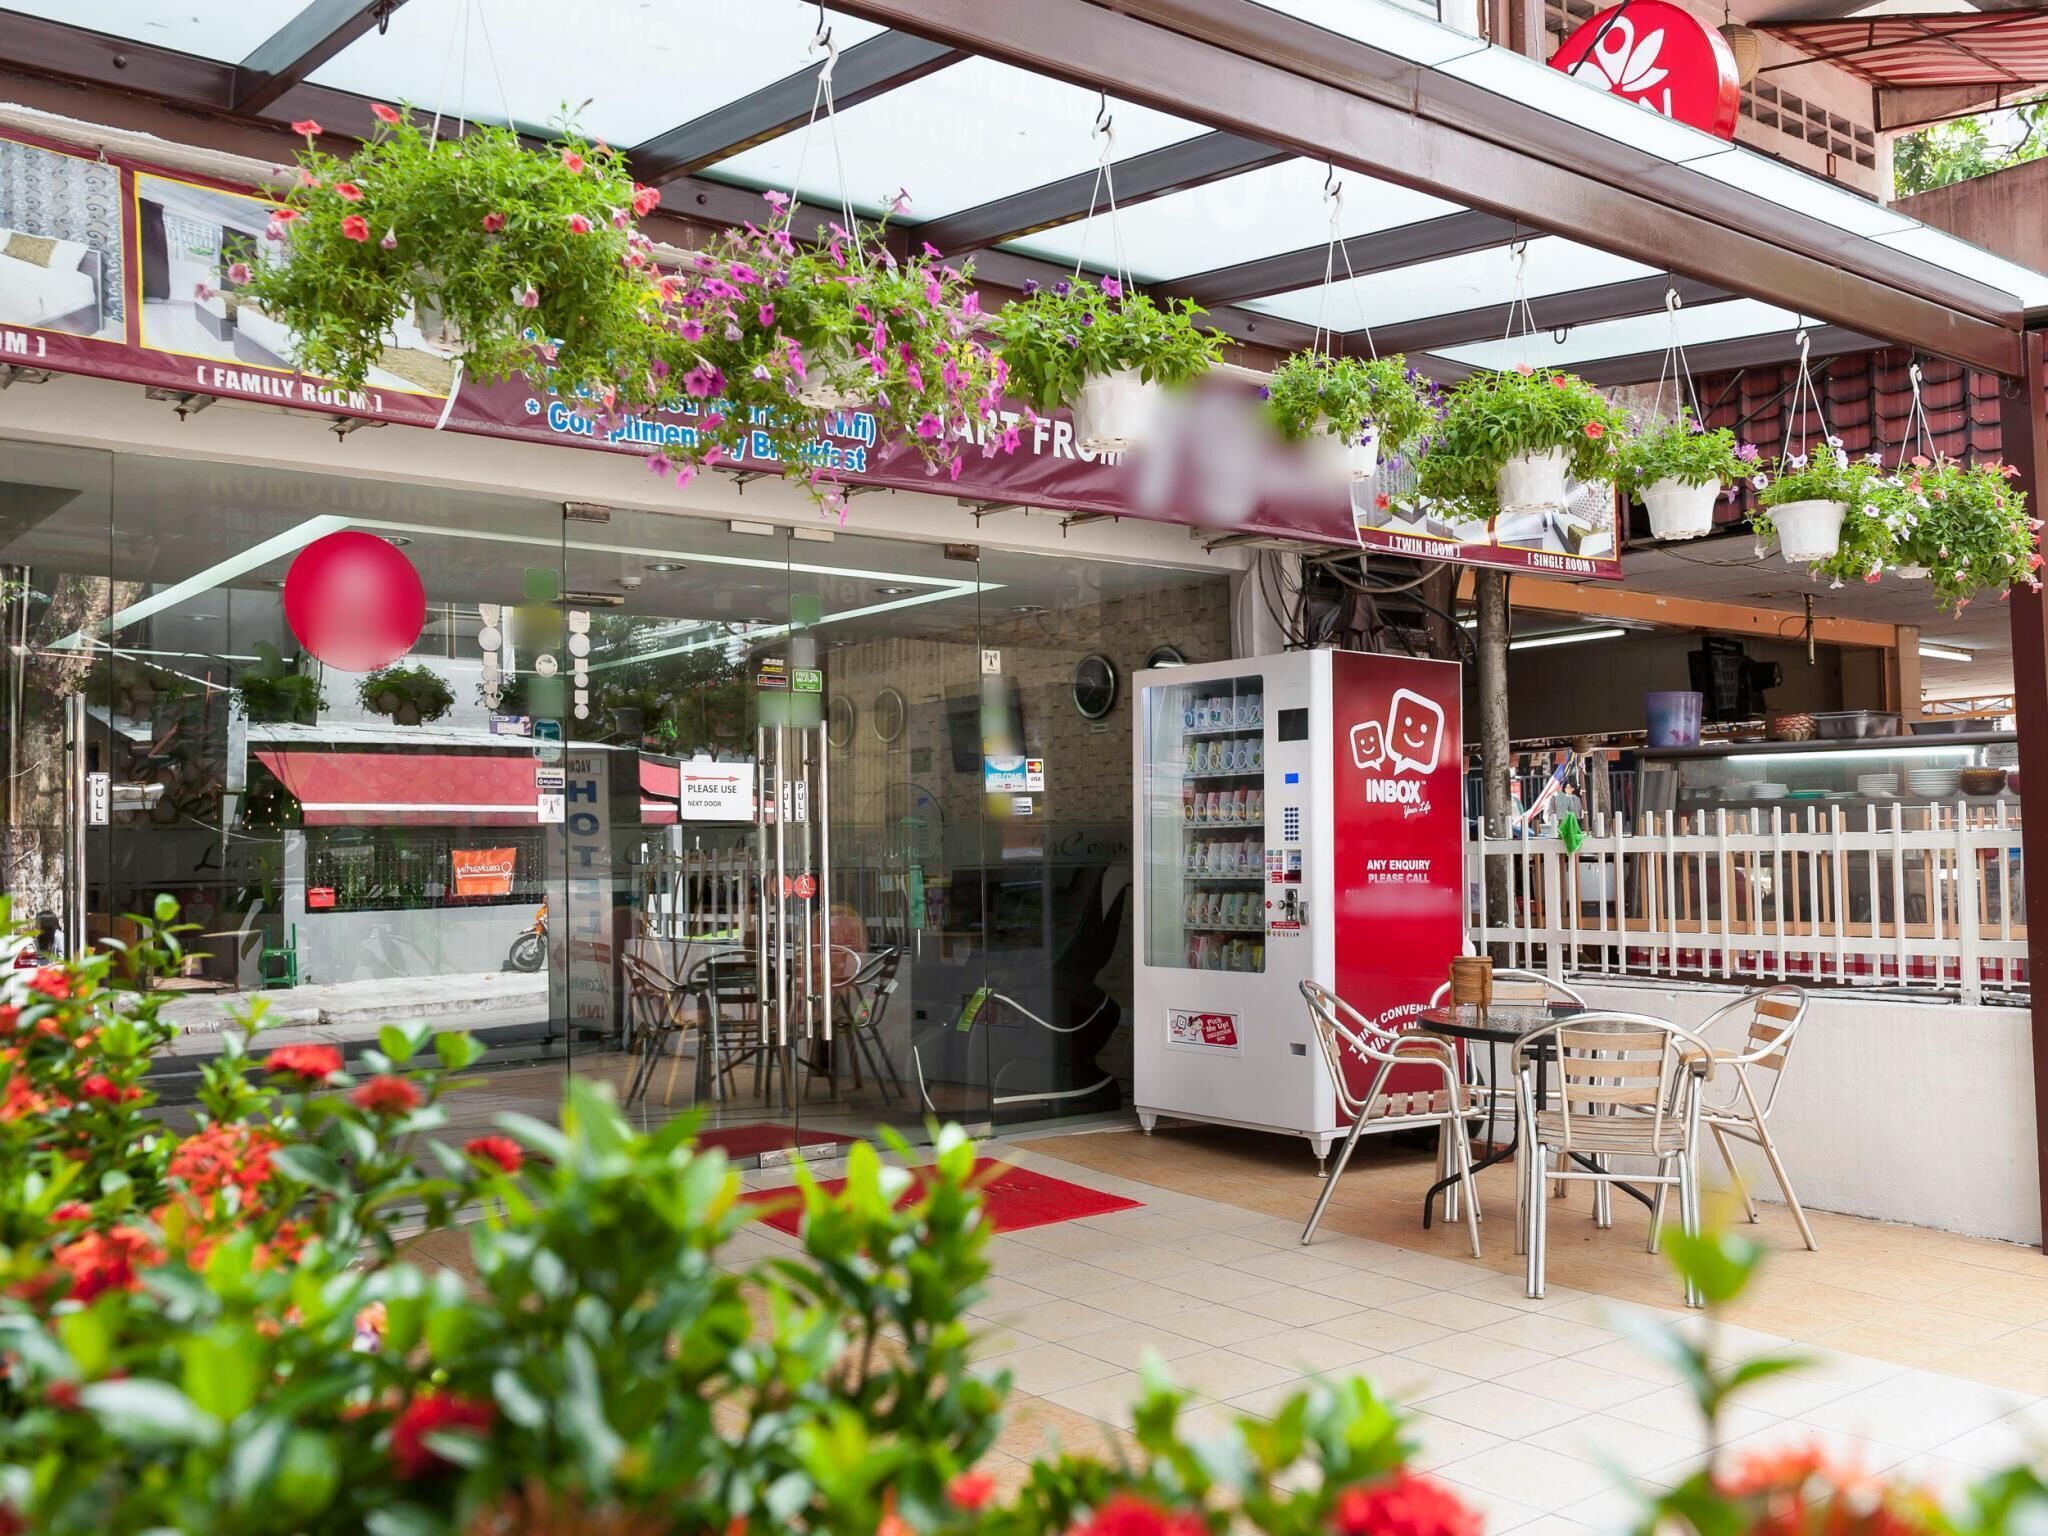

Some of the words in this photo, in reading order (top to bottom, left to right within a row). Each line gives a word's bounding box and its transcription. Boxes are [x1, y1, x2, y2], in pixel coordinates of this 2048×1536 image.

[0, 331, 27, 354] M
[214, 367, 294, 398] FAMILY
[302, 382, 366, 411] ROOM
[1033, 417, 1122, 466] FR
[1395, 536, 1424, 553] TWIN
[1425, 540, 1454, 557] ROOM
[1533, 554, 1564, 569] SINGLE
[1565, 557, 1590, 572] ROOM
[988, 772, 1023, 781] WELCOME
[687, 784, 719, 793] PLEASE
[721, 785, 737, 793] USE
[1366, 778, 1420, 803] INBOX
[1403, 804, 1418, 819] Your
[1419, 801, 1431, 815] Life
[1367, 860, 1387, 870] ANY
[1389, 860, 1431, 871] ENQUIRY
[1368, 874, 1404, 883] PLEASE
[1406, 873, 1430, 883] CALL
[1207, 1017, 1222, 1026] Pick
[1217, 1021, 1229, 1029] Up!
